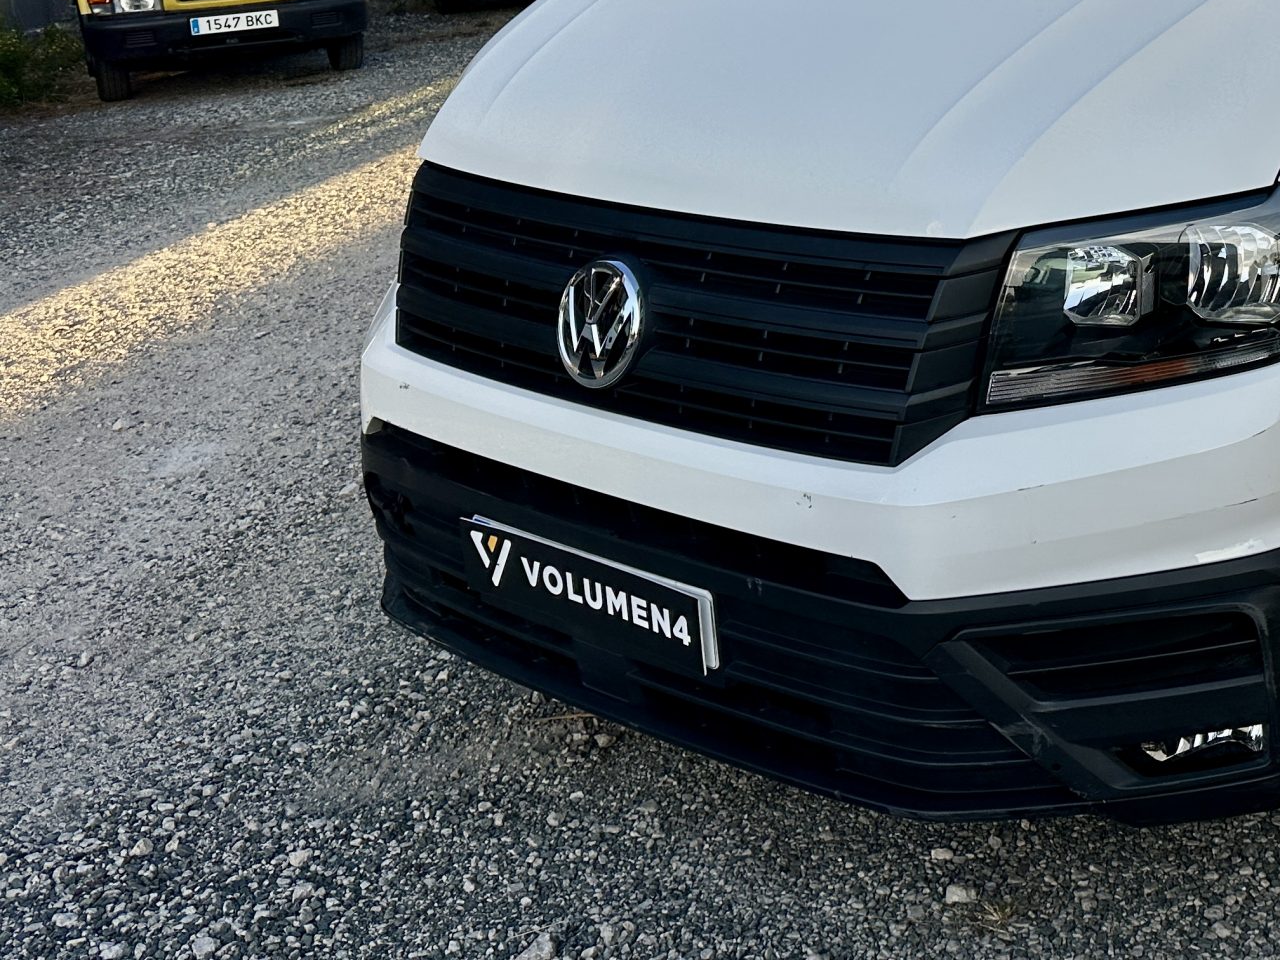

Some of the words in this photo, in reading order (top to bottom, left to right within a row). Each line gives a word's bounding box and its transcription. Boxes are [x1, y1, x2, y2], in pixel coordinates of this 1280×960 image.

[206, 16, 241, 31] 1547
[246, 13, 273, 28] BKC
[520, 556, 691, 646] VOLUMEN4
